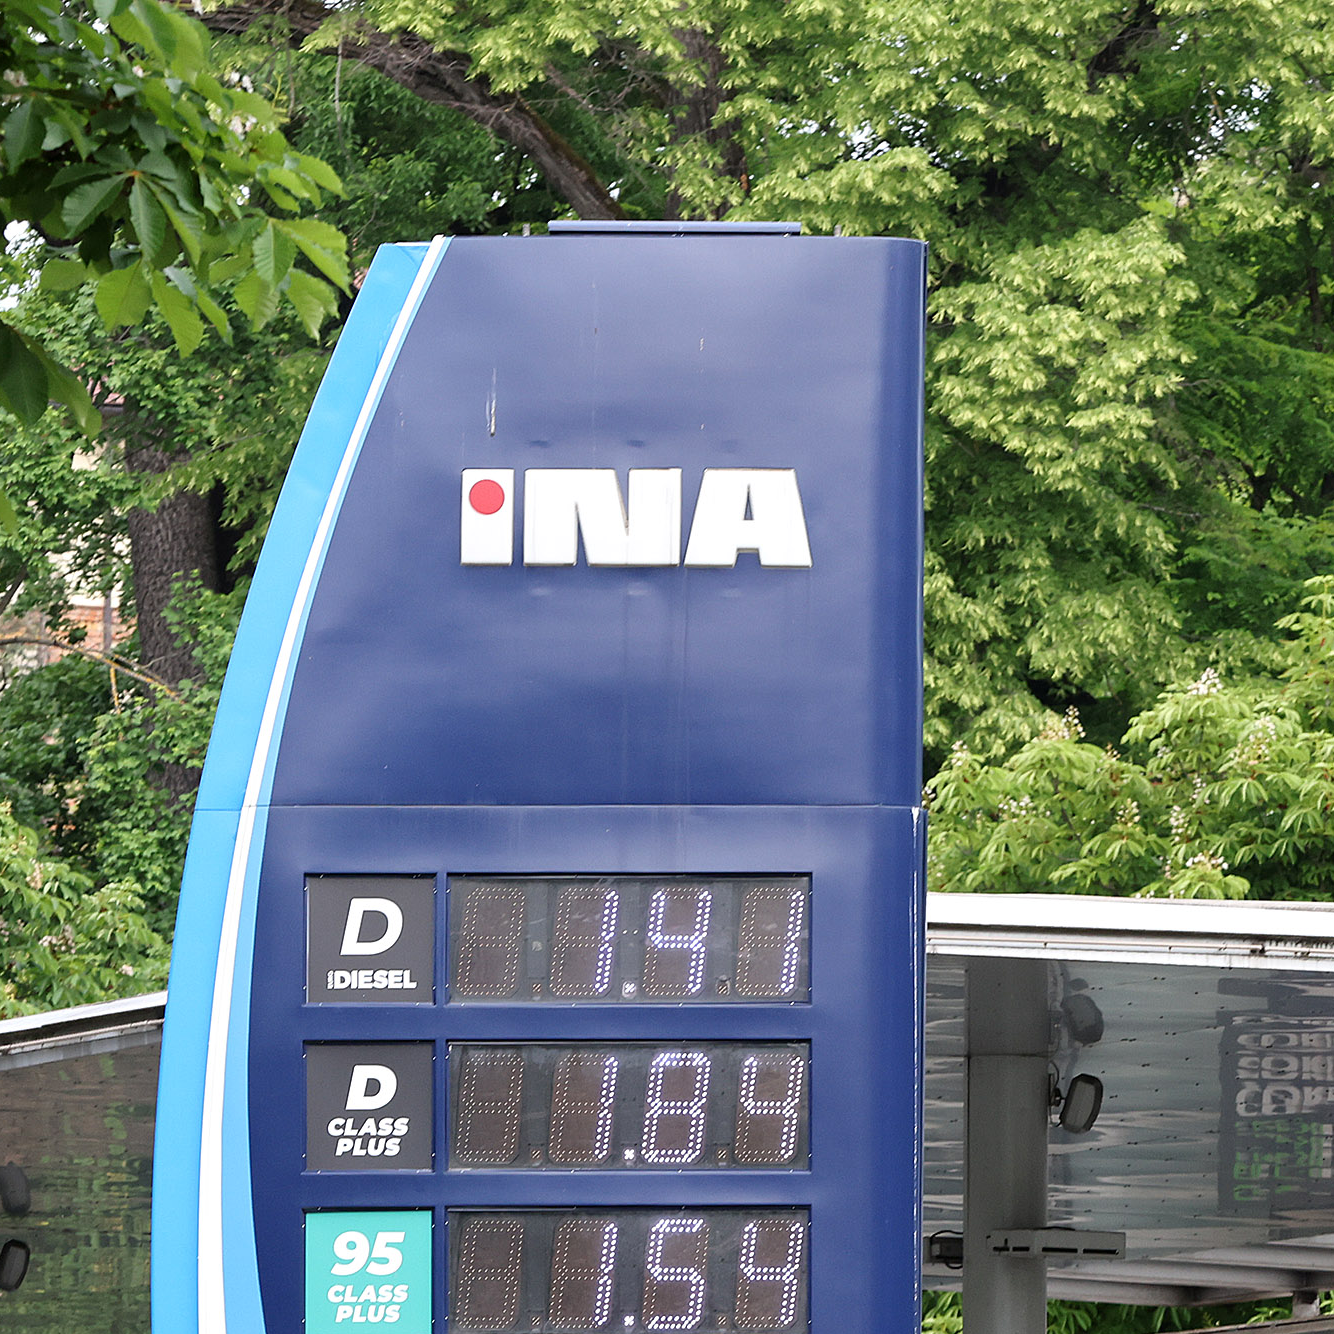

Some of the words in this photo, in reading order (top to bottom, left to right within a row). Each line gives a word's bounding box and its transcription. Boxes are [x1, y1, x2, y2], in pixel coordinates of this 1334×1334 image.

[460, 467, 813, 568] INA
[339, 897, 404, 956] D
[594, 887, 805, 996] 1.41
[345, 1064, 398, 1110] D
[594, 1052, 805, 1163] 1.84
[327, 1117, 410, 1137] CLASS
[334, 1137, 402, 1157] PLUS
[330, 1230, 406, 1276] 95
[594, 1218, 805, 1330] 1.54
[327, 1284, 409, 1303] CLASS
[334, 1304, 401, 1323] PLUS
